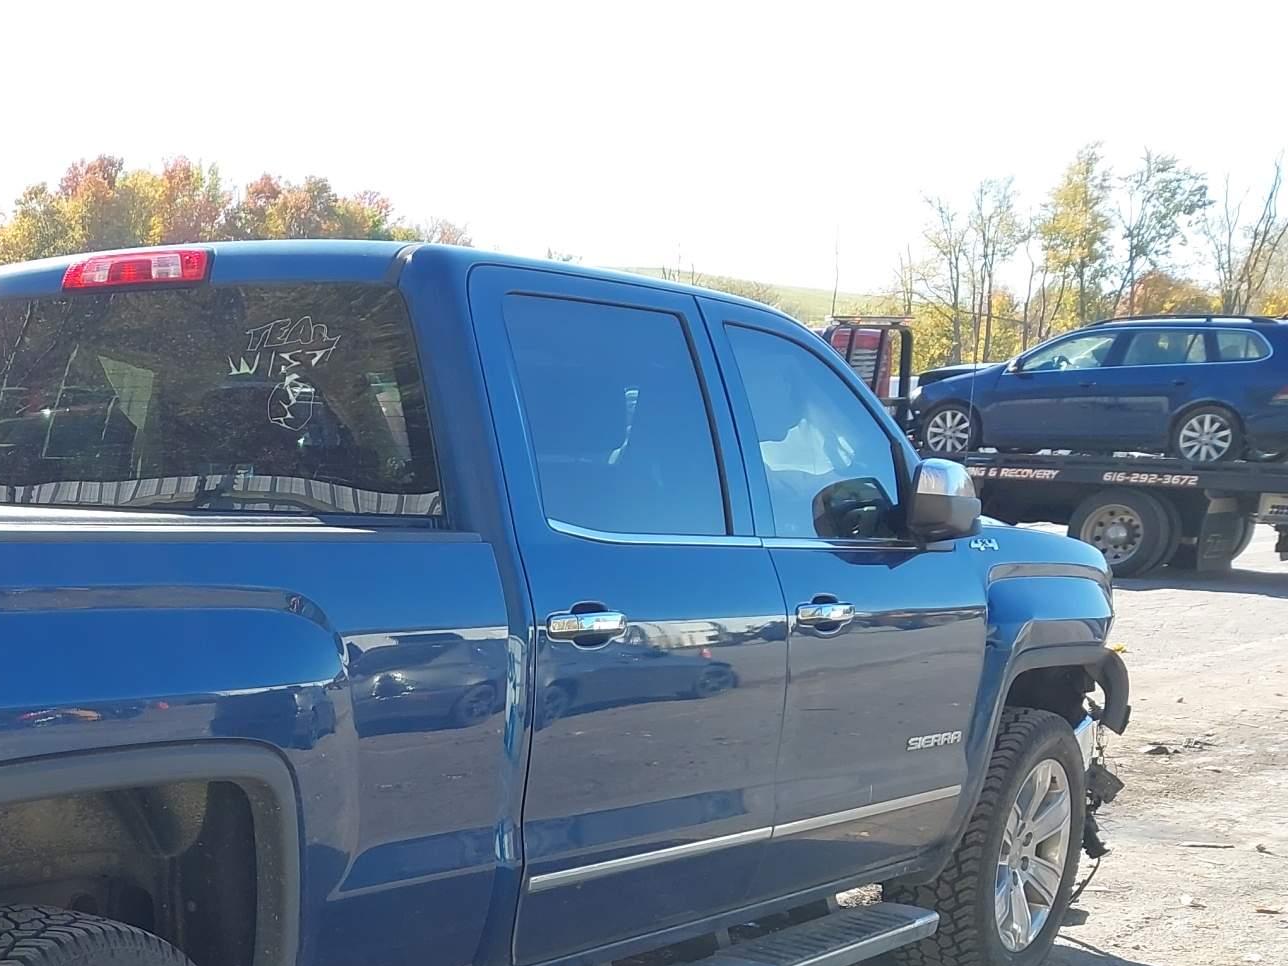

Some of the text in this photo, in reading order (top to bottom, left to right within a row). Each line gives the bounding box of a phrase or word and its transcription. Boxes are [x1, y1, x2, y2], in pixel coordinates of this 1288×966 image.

[988, 468, 998, 478] &
[999, 468, 1060, 480] RECOVERY
[1103, 472, 1199, 486] 616-292-3672
[907, 731, 962, 751] SIERRA
